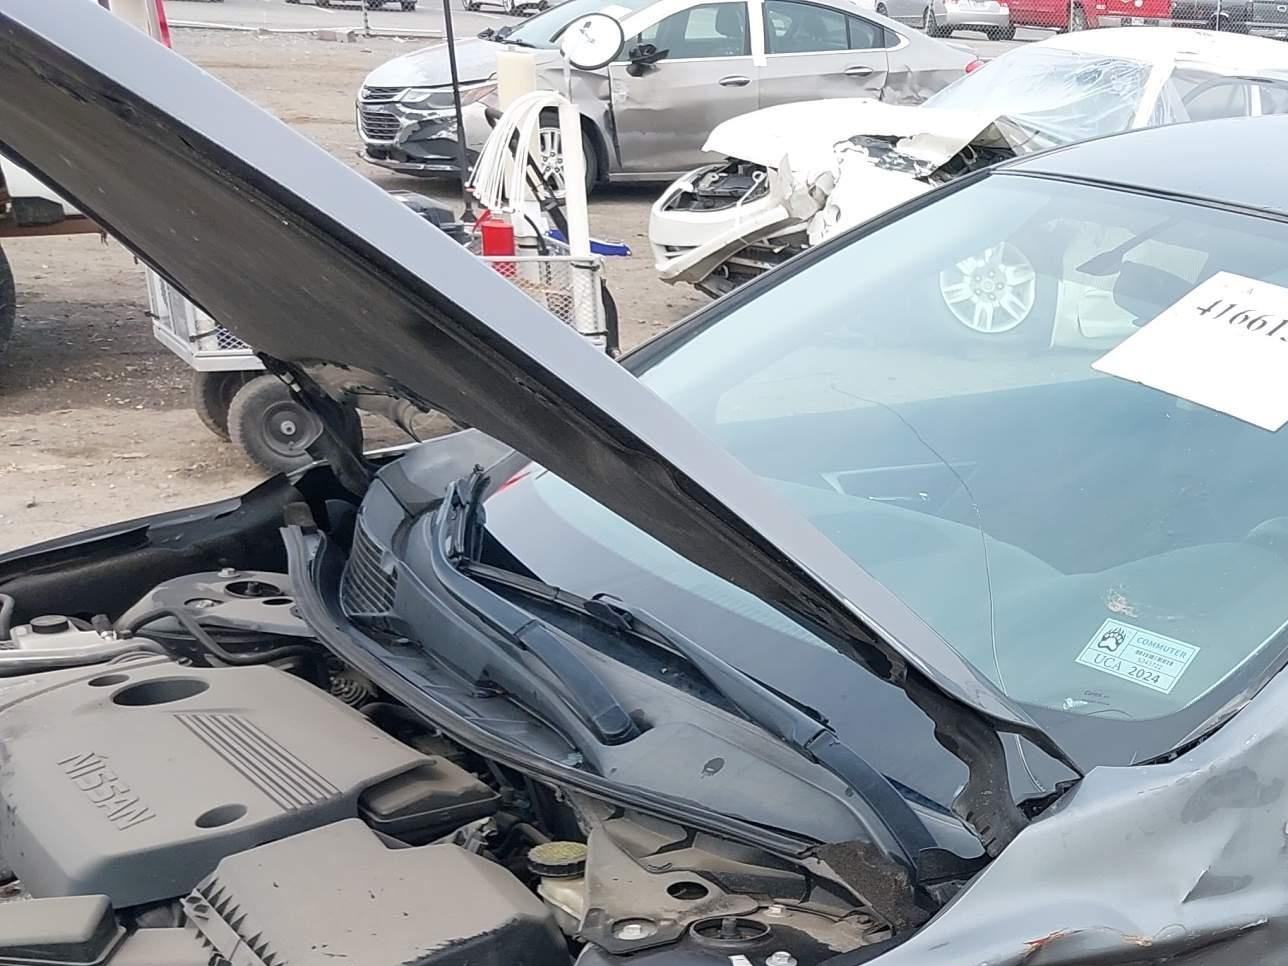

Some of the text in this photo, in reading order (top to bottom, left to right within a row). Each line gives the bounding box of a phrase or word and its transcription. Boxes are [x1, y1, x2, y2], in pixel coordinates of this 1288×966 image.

[1136, 636, 1188, 659] COMMUTER
[1093, 653, 1121, 671] UCA
[1128, 666, 1160, 684] 2024
[56, 752, 157, 832] NISSAN
